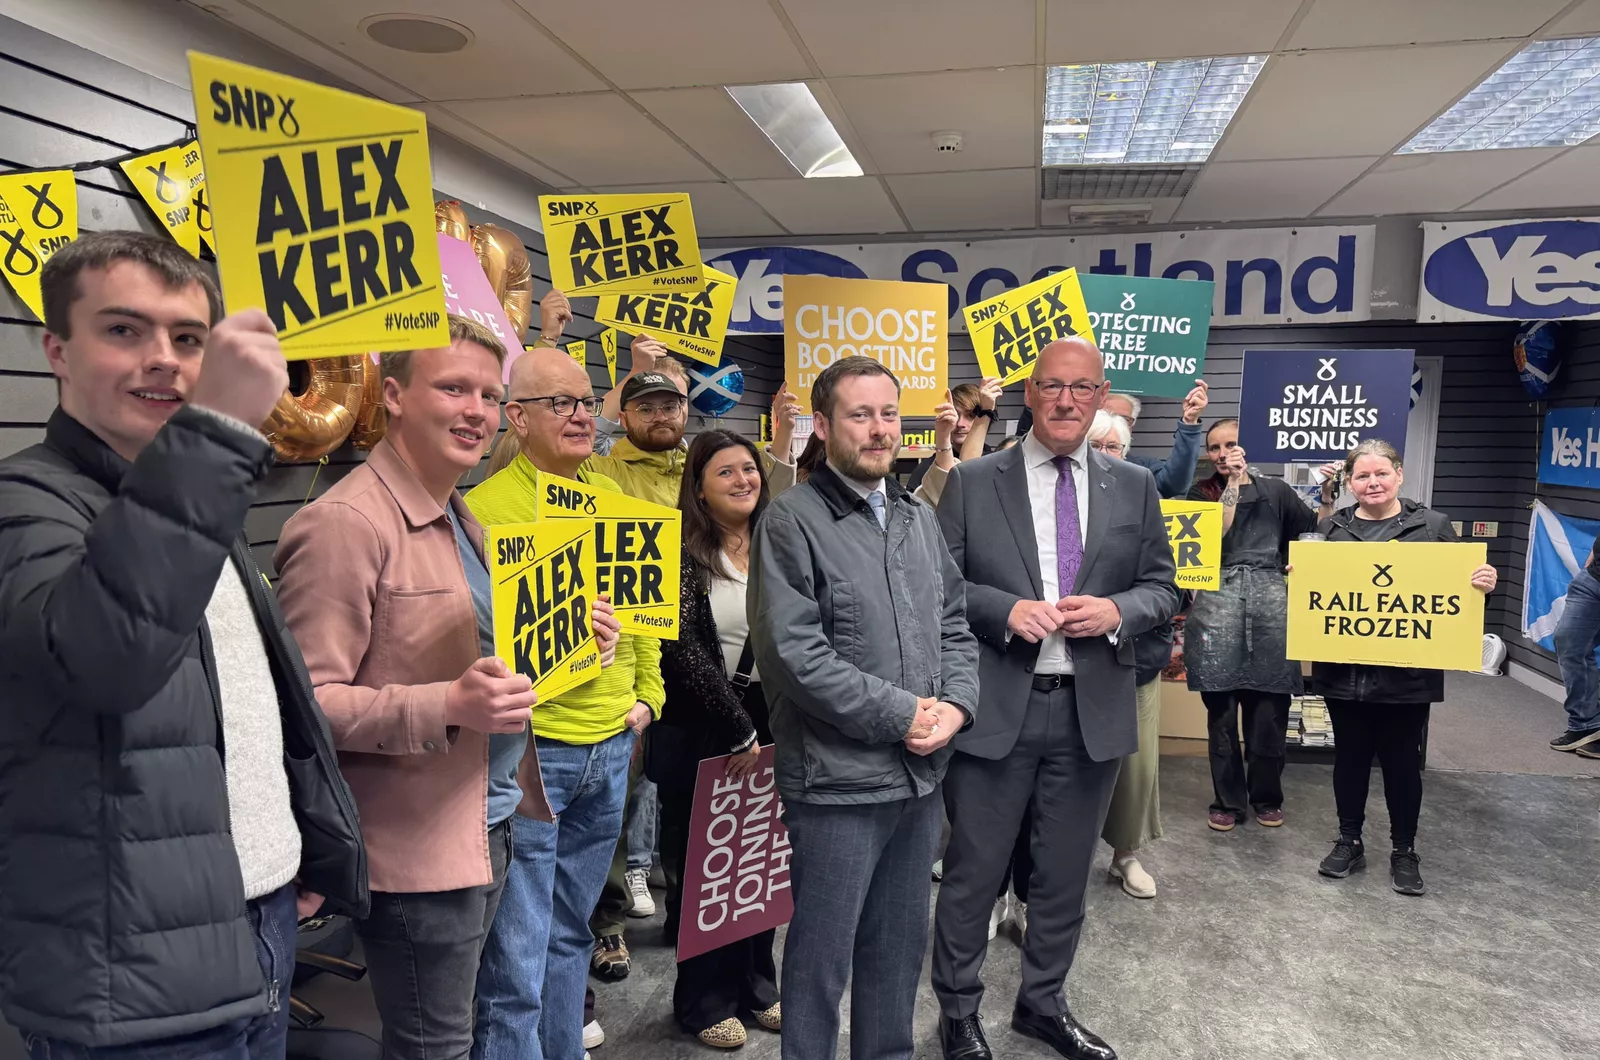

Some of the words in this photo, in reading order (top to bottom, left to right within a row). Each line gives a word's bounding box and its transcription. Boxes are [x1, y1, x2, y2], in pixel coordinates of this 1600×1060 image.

[209, 79, 275, 132] SNP
[255, 140, 410, 246] ALEX
[166, 206, 190, 227] SNP
[548, 201, 584, 216] SNP
[569, 206, 675, 255] ALEX
[257, 220, 423, 332] KERR
[570, 238, 685, 287] KERR
[652, 276, 698, 286] #VoteSNP
[384, 312, 440, 331] #VoteSNP
[615, 294, 712, 338] KERR
[795, 304, 937, 343] CHOOSE
[971, 304, 998, 324] SNP
[993, 284, 1068, 353] ALEX
[1087, 311, 1191, 335] OTECTING
[678, 339, 716, 358] #VoteSNP
[994, 314, 1079, 379] KERR
[1099, 332, 1147, 352] FREE
[1101, 352, 1197, 375] RIPTIONS
[1283, 384, 1367, 406] SMALL
[1268, 407, 1378, 429] BUSINESS
[1275, 431, 1361, 451] BONUS
[1551, 427, 1582, 467] Yes
[546, 484, 583, 511] SNP
[497, 536, 525, 566] SNP
[595, 522, 664, 563] LEX
[513, 539, 585, 639] ALEX
[596, 564, 664, 606] ERR
[1177, 574, 1213, 583] VoteSNP
[1308, 590, 1370, 612] RAIL
[1377, 593, 1461, 616] FARES
[633, 613, 674, 628] #VoteSNP
[1323, 615, 1433, 640] FROZEN
[513, 595, 590, 685] KERR
[570, 652, 598, 674] #VoteSNP
[697, 774, 744, 932] CHOOSE
[732, 766, 775, 921] JOINING
[766, 830, 793, 900] THE
